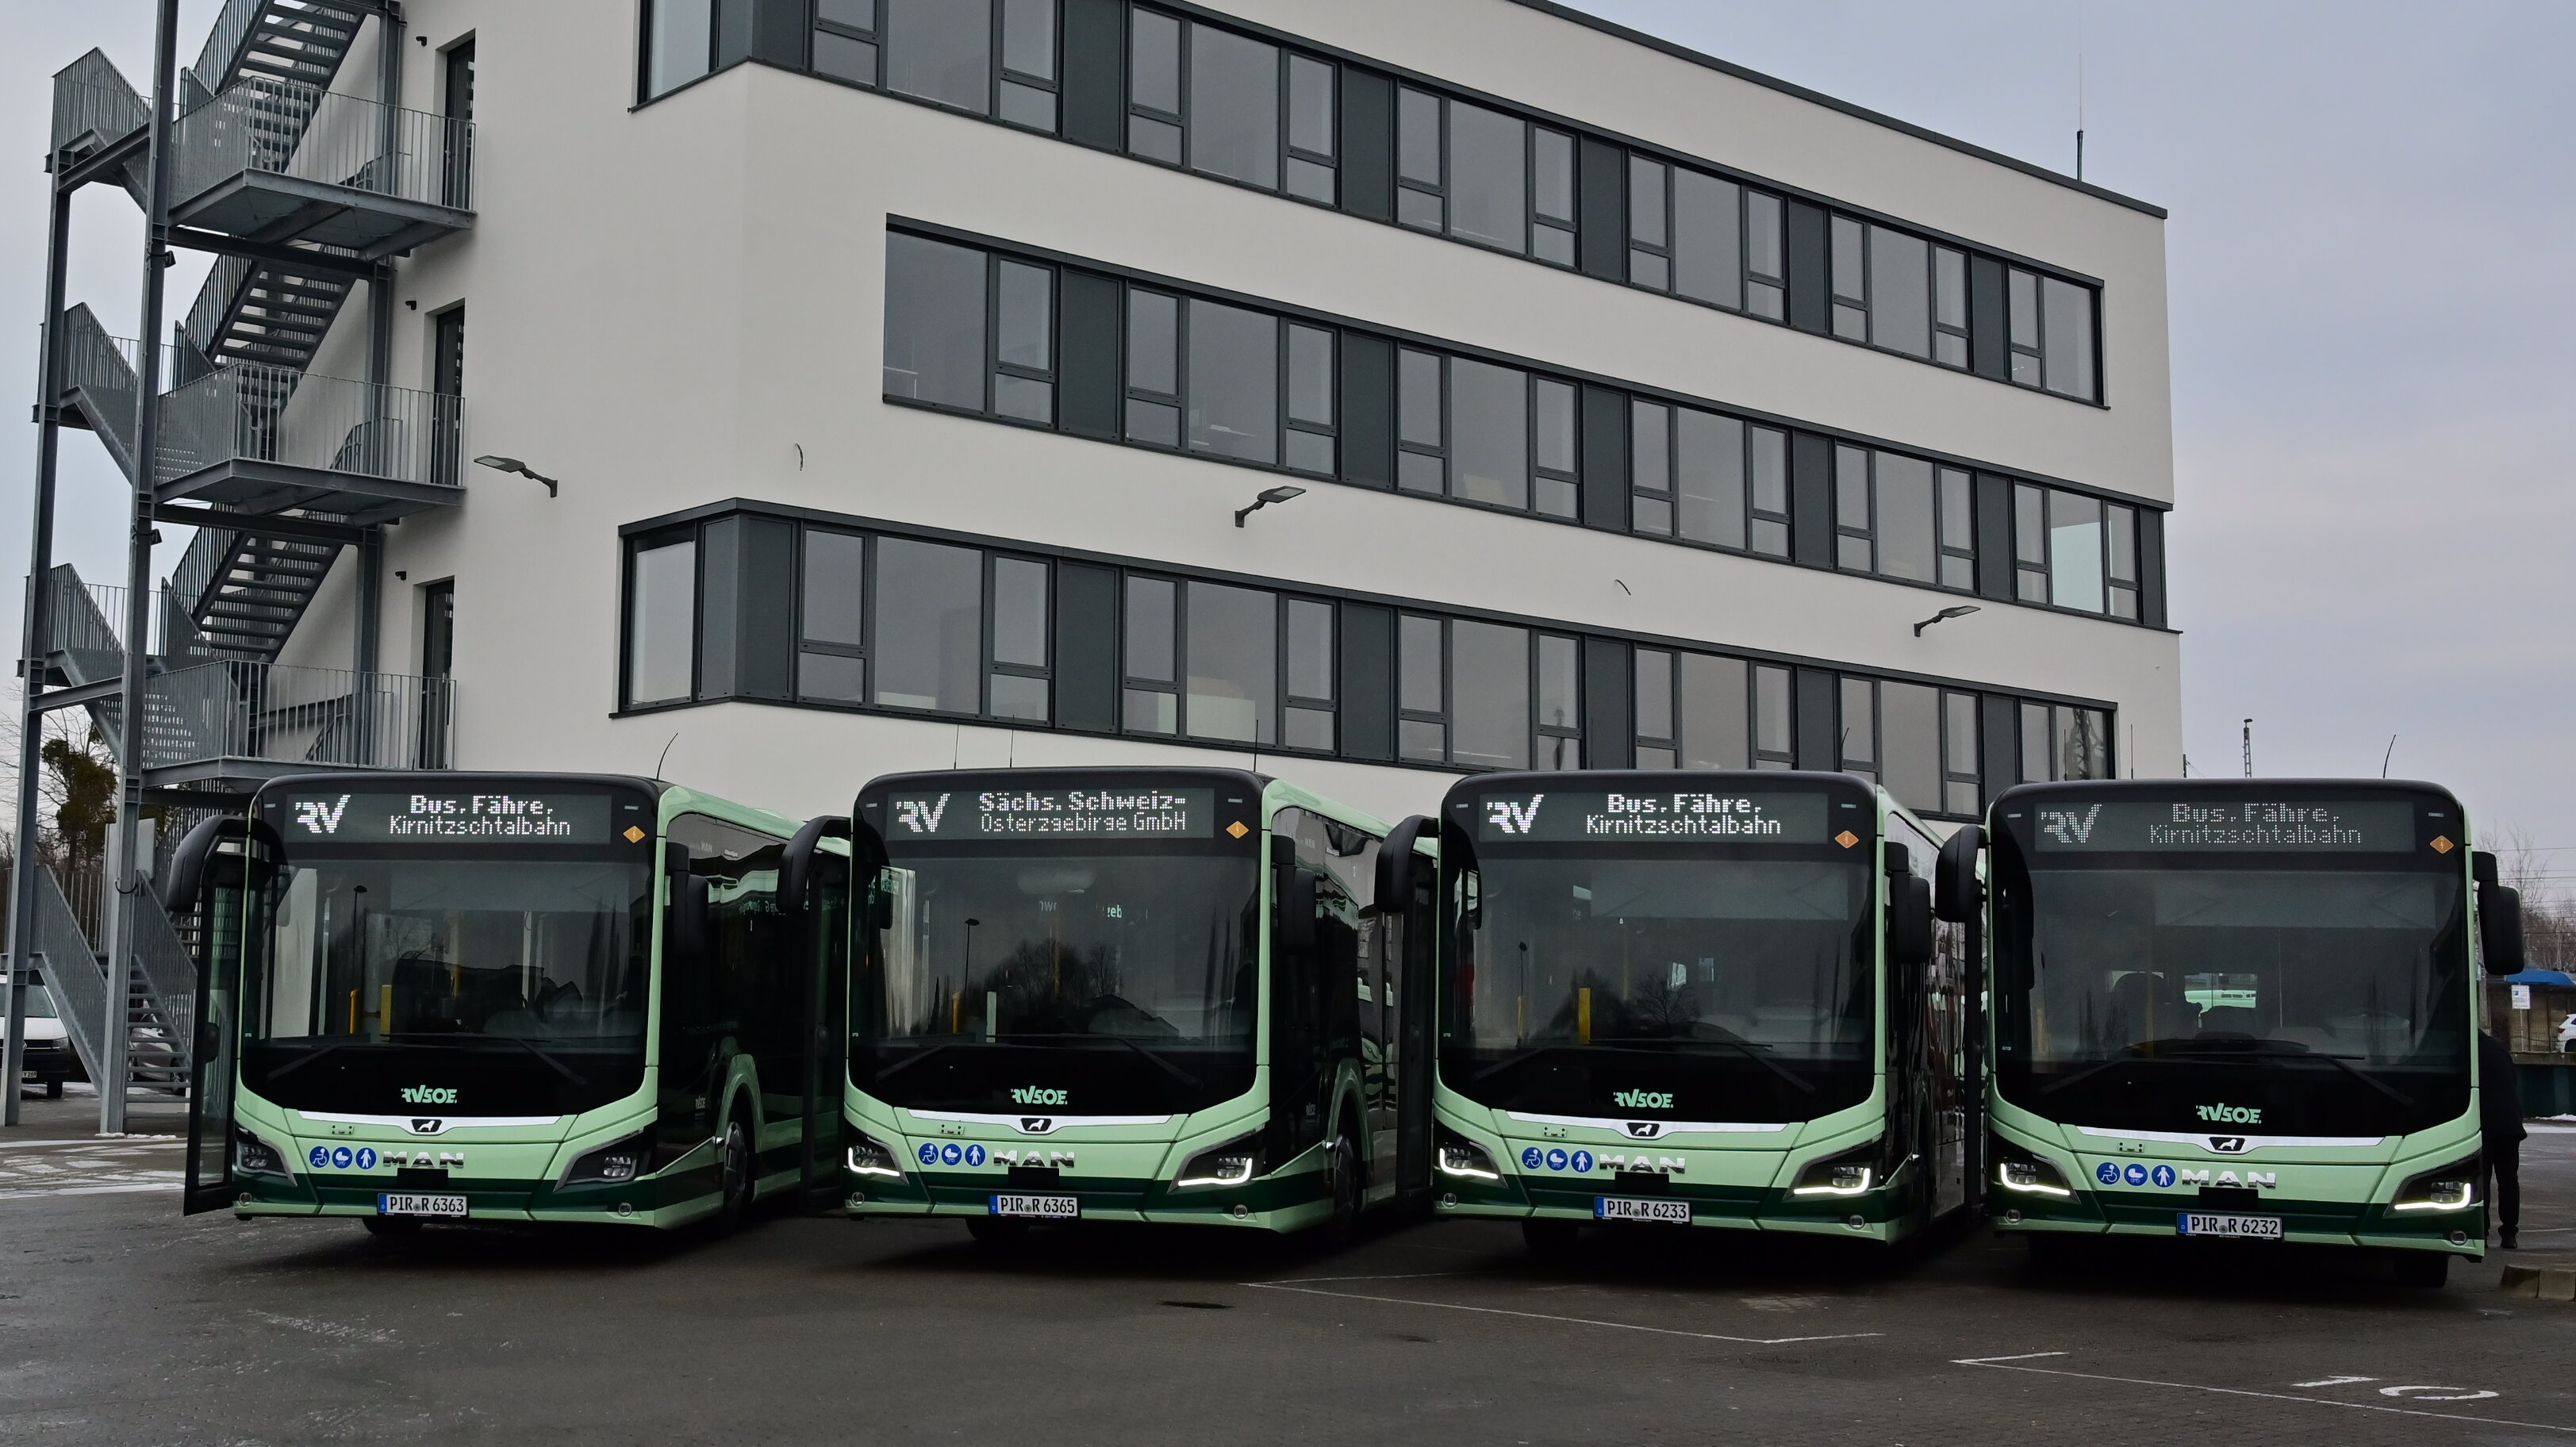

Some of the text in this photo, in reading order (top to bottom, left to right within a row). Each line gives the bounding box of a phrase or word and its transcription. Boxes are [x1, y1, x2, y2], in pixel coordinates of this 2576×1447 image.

[410, 795, 553, 814] Bus, Fähre,
[979, 790, 1185, 811] Sächs. Schweiz-
[1608, 794, 1761, 812] Bus, Fähre,
[294, 794, 351, 834] RV
[896, 792, 950, 832] RV
[981, 811, 1185, 831] Osterzgebirge GmbH
[1487, 794, 1544, 834] RV
[390, 815, 570, 835] Kirnitzschtalbahn
[1587, 815, 1781, 834] Kirnitzschtalbahn
[2040, 804, 2102, 843] RV
[2150, 824, 2361, 843] Kirnitzschtalbahn
[383, 1150, 464, 1169] MAN
[993, 1150, 1074, 1168] MAN
[1599, 1153, 1685, 1174] MAN
[2182, 1169, 2276, 1189] MAN
[390, 1196, 464, 1212] PIR R 6363
[1000, 1197, 1075, 1213] PIR R 6365
[1607, 1200, 1687, 1219] PIR R 6233
[2191, 1217, 2278, 1234] PIR R 6232
